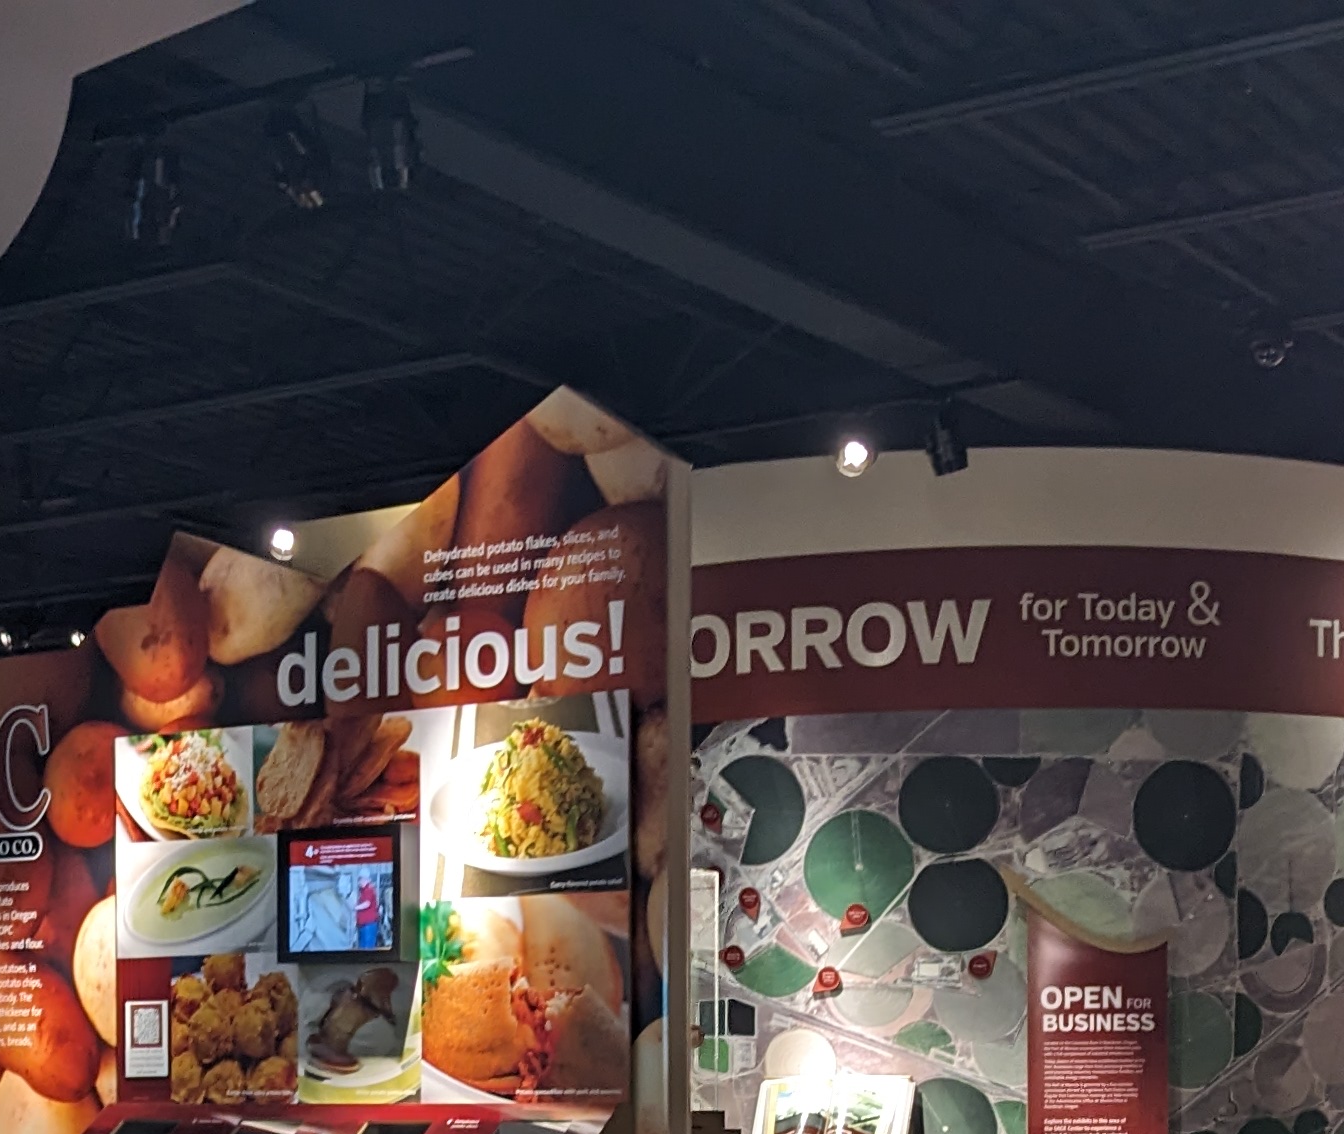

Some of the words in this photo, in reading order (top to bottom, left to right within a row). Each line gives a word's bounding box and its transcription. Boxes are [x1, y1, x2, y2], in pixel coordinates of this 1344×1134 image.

[423, 542, 485, 564] Dehydrated
[486, 539, 524, 558] potato
[525, 534, 560, 551] flakes,
[597, 525, 620, 541] and
[423, 567, 454, 583] cubes
[455, 565, 474, 579] can
[476, 563, 490, 577] be
[492, 558, 519, 575] used
[520, 556, 531, 570] in
[533, 553, 564, 571] many
[566, 550, 606, 566] recipes
[608, 547, 621, 560] to
[423, 586, 456, 603] create
[457, 582, 504, 599] delicious
[506, 577, 540, 594] dishes
[542, 573, 559, 589] for
[560, 572, 587, 591] your
[588, 567, 626, 585] family.
[1019, 592, 1069, 622] for
[1078, 592, 1176, 630] Today
[1187, 580, 1221, 627] &
[277, 600, 626, 708] delicious!
[690, 598, 993, 679] ORROW
[1041, 628, 1207, 659] Tomorrow
[12, 838, 37, 856] CO.
[1040, 985, 1123, 1011] OPEN
[1126, 997, 1152, 1010] FOR
[1042, 1012, 1156, 1033] BUSINESS
